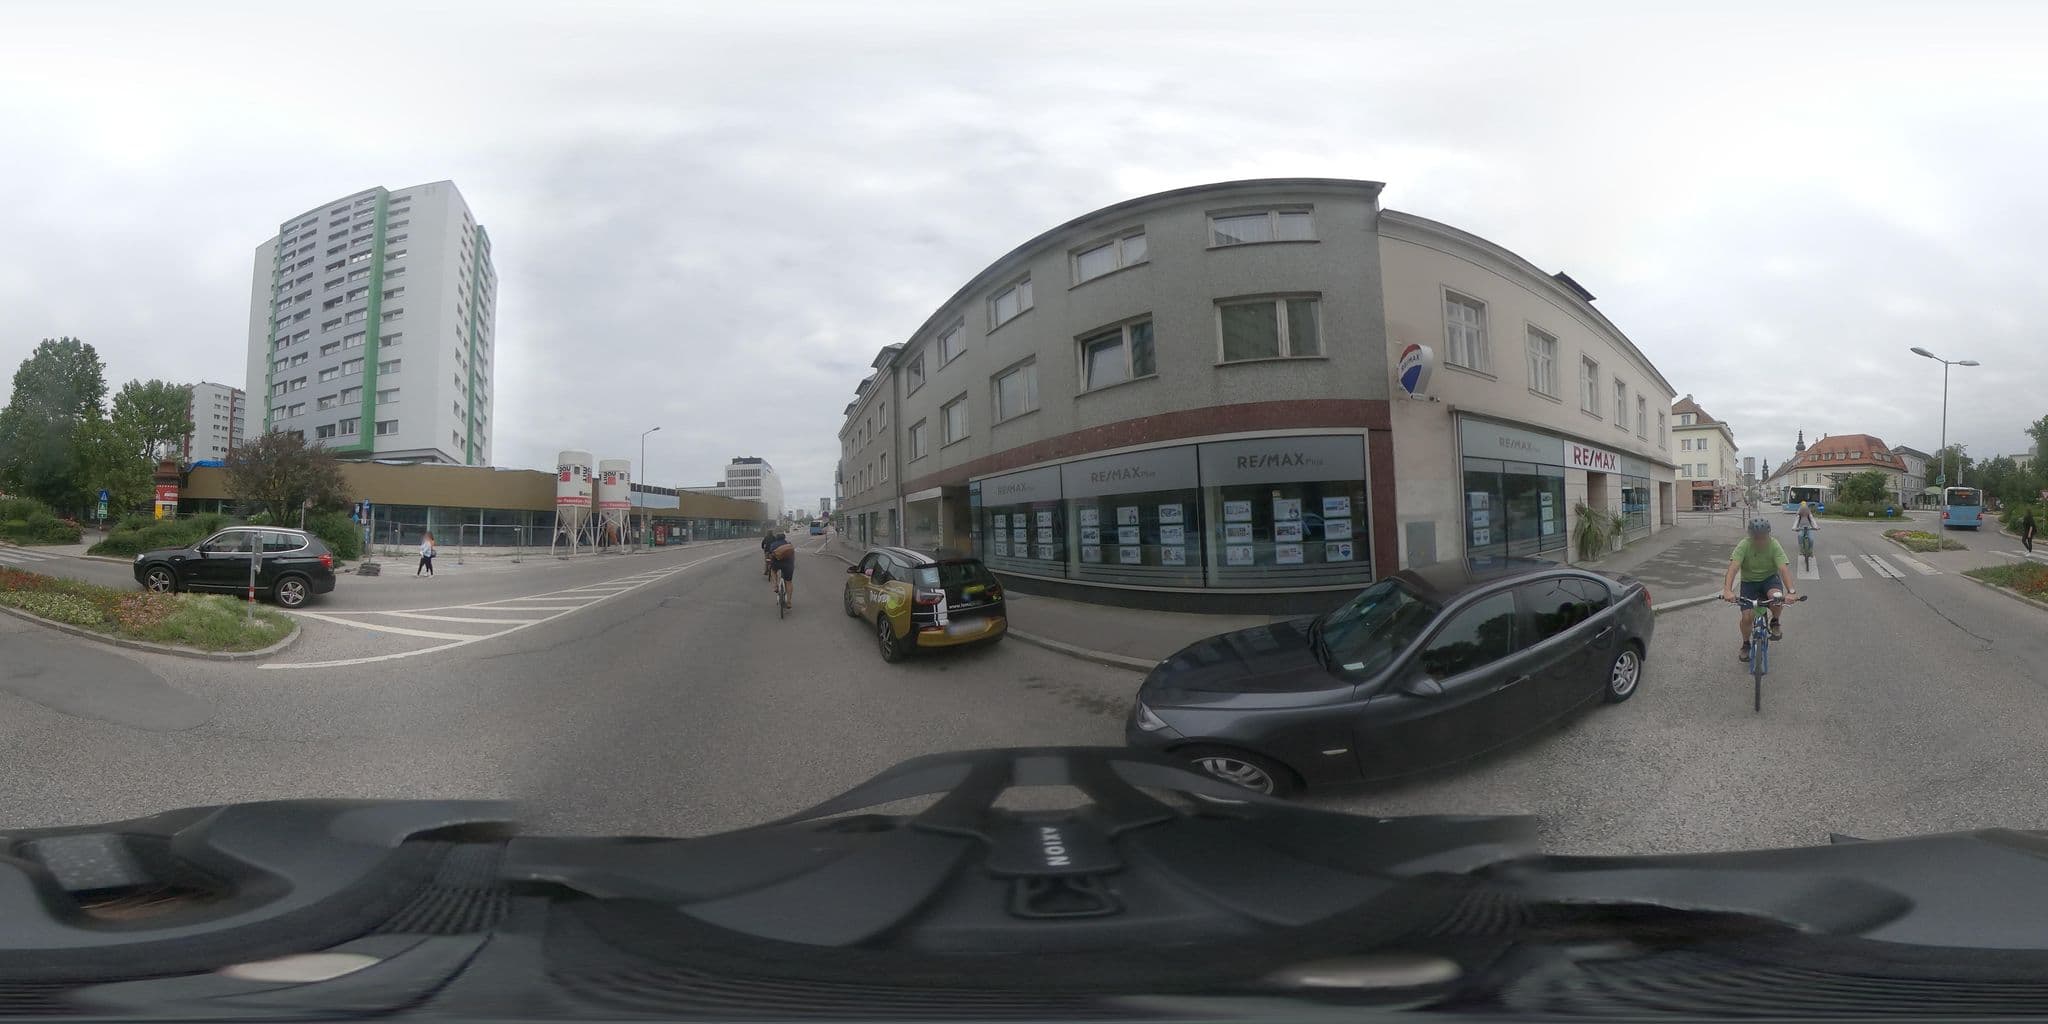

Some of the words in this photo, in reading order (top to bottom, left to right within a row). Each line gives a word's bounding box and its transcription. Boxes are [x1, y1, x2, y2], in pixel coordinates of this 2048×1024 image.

[1237, 452, 1304, 469] RE/MAX
[1573, 446, 1616, 470] RE/MAX
[1090, 465, 1141, 483] RE/MAX
[1040, 827, 1071, 866] AXION
